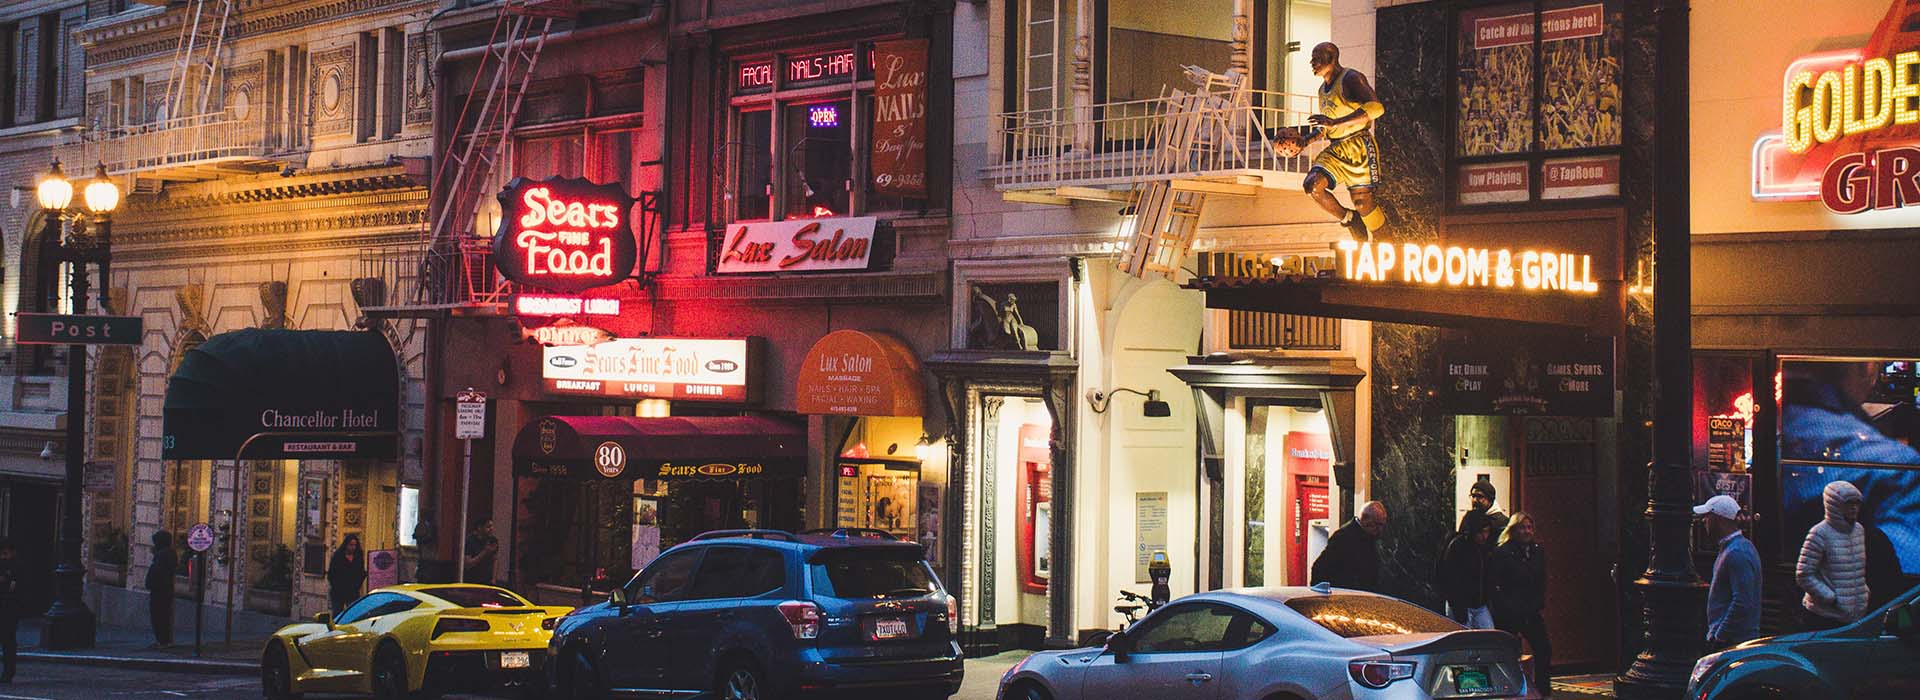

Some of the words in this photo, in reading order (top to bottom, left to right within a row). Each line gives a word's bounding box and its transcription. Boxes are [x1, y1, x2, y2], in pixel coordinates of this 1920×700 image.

[1480, 26, 1505, 40] Catch
[1507, 24, 1519, 37] all
[1572, 14, 1597, 28] here!
[742, 65, 773, 87] FACIAL
[877, 93, 924, 122] NAILS
[1786, 52, 1920, 153] GOLDE
[812, 110, 835, 122] OPEN
[521, 187, 618, 228] Sears
[558, 232, 589, 245] FINE
[722, 226, 775, 263] Lux
[779, 222, 868, 268] Salon
[517, 230, 612, 276] Food
[1339, 240, 1395, 281] TAP
[1403, 243, 1488, 286] ROOM
[1496, 249, 1514, 287] &
[1521, 252, 1598, 292] GRILL
[51, 322, 112, 337] Post
[583, 350, 626, 374] Sears
[628, 346, 659, 375] Fine
[662, 346, 698, 376] Food
[820, 353, 839, 372] Lux
[841, 353, 872, 372] Salon
[556, 381, 601, 390] BREAKFAST
[624, 383, 655, 392] LUNCH
[686, 385, 723, 395] DINNER
[808, 384, 831, 392] NAILS
[839, 385, 858, 393] HAIR
[811, 395, 837, 403] FACIAL
[847, 395, 878, 403] WAXING
[262, 409, 338, 427] Chancellor
[343, 409, 377, 427] Hotel
[599, 446, 621, 467] 80
[658, 463, 697, 476] Sears
[738, 463, 762, 474] Food
